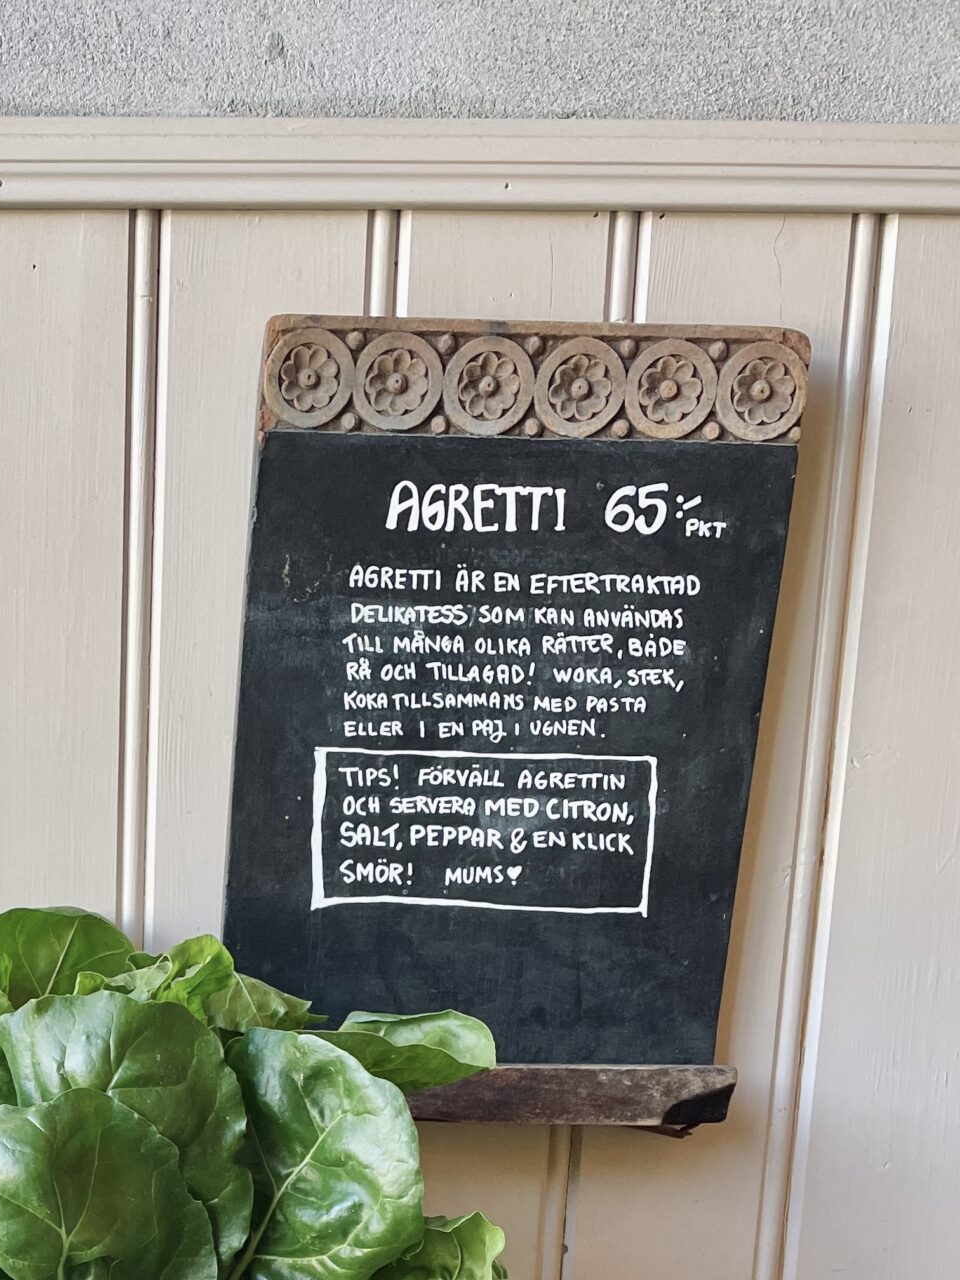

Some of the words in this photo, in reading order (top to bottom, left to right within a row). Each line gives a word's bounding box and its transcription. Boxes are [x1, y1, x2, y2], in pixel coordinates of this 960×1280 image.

[385, 480, 567, 533] AGRETTI
[685, 518, 727, 539] PKT
[349, 564, 441, 591] AGRETTI
[455, 563, 486, 593] ÄR
[493, 571, 521, 593] EN
[529, 571, 701, 596] EFTERTRAKTAD
[478, 604, 525, 625] SOM
[534, 606, 575, 627] KAN
[583, 604, 684, 629] ANVÄNDAS
[341, 632, 384, 654] TILL
[393, 629, 465, 654] MÅNGA
[474, 637, 531, 657] OLIKA
[541, 631, 623, 660] RÄTTER,
[346, 656, 372, 682] RÅ
[380, 661, 417, 682] OCH
[425, 661, 536, 686] TILLAGAD!
[552, 666, 623, 689] WOKA,
[626, 668, 685, 693] STEK,
[343, 690, 388, 711] KOKA
[391, 691, 524, 711] TILLSAMMANS
[533, 695, 578, 713] MED
[585, 695, 647, 714] PASTA
[343, 720, 404, 738] ELLER
[419, 720, 425, 738] I
[437, 721, 465, 739] EN
[471, 718, 508, 744] PAJ
[514, 722, 520, 736] I
[529, 718, 606, 738] UGNEN.
[337, 763, 399, 790] TIPS!
[418, 763, 505, 788] FÖRVÄLL
[517, 769, 626, 791] AGRETTIN
[342, 795, 380, 817] OCH
[389, 795, 476, 817] SERVERA
[484, 797, 540, 818] MED
[545, 797, 635, 826] CITRON,
[339, 821, 403, 851] SALT,
[409, 824, 504, 850] PEPPAR
[509, 827, 528, 854] &
[532, 830, 566, 848] EN
[571, 832, 634, 856] KLICK
[339, 858, 413, 886] SMÖR!
